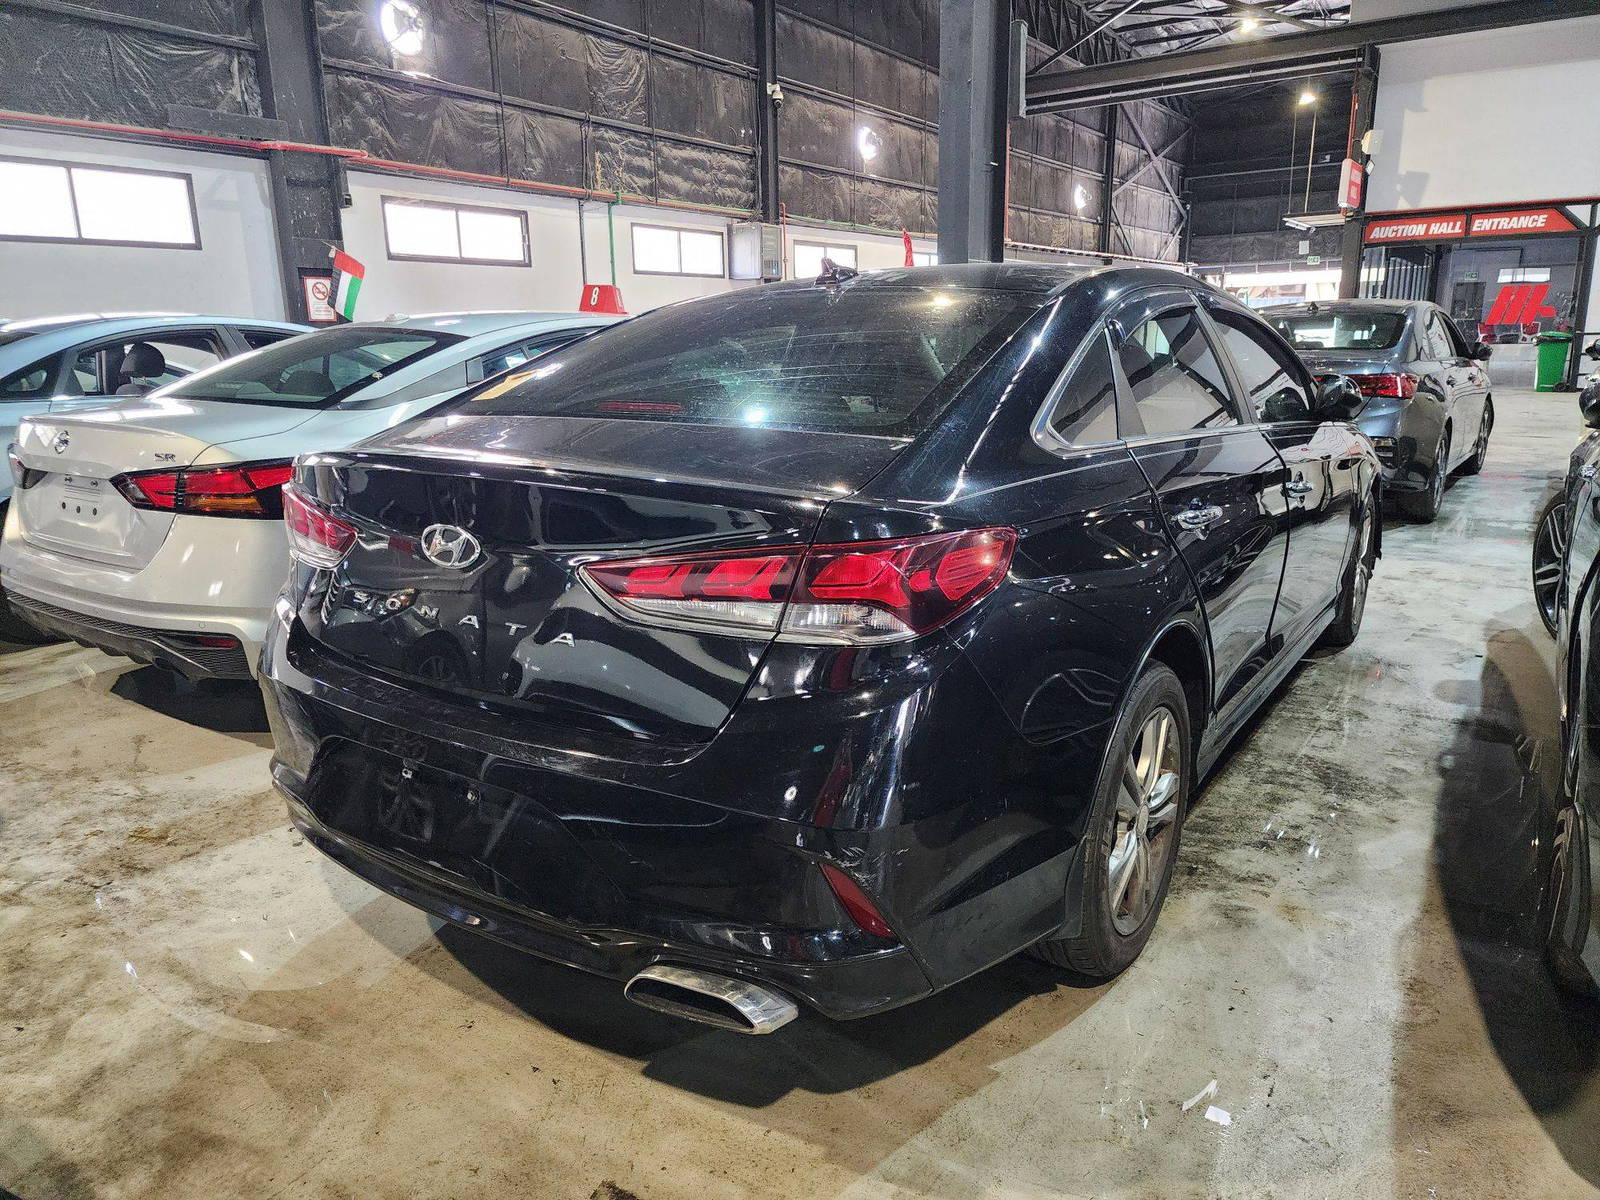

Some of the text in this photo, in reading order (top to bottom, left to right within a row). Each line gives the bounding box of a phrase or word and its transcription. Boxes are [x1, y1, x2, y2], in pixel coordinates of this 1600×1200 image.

[1369, 214, 1548, 239] AUCTION HALL ENTRANCE
[590, 286, 600, 306] 8
[154, 452, 176, 462] SR
[353, 590, 575, 647] SONATA
